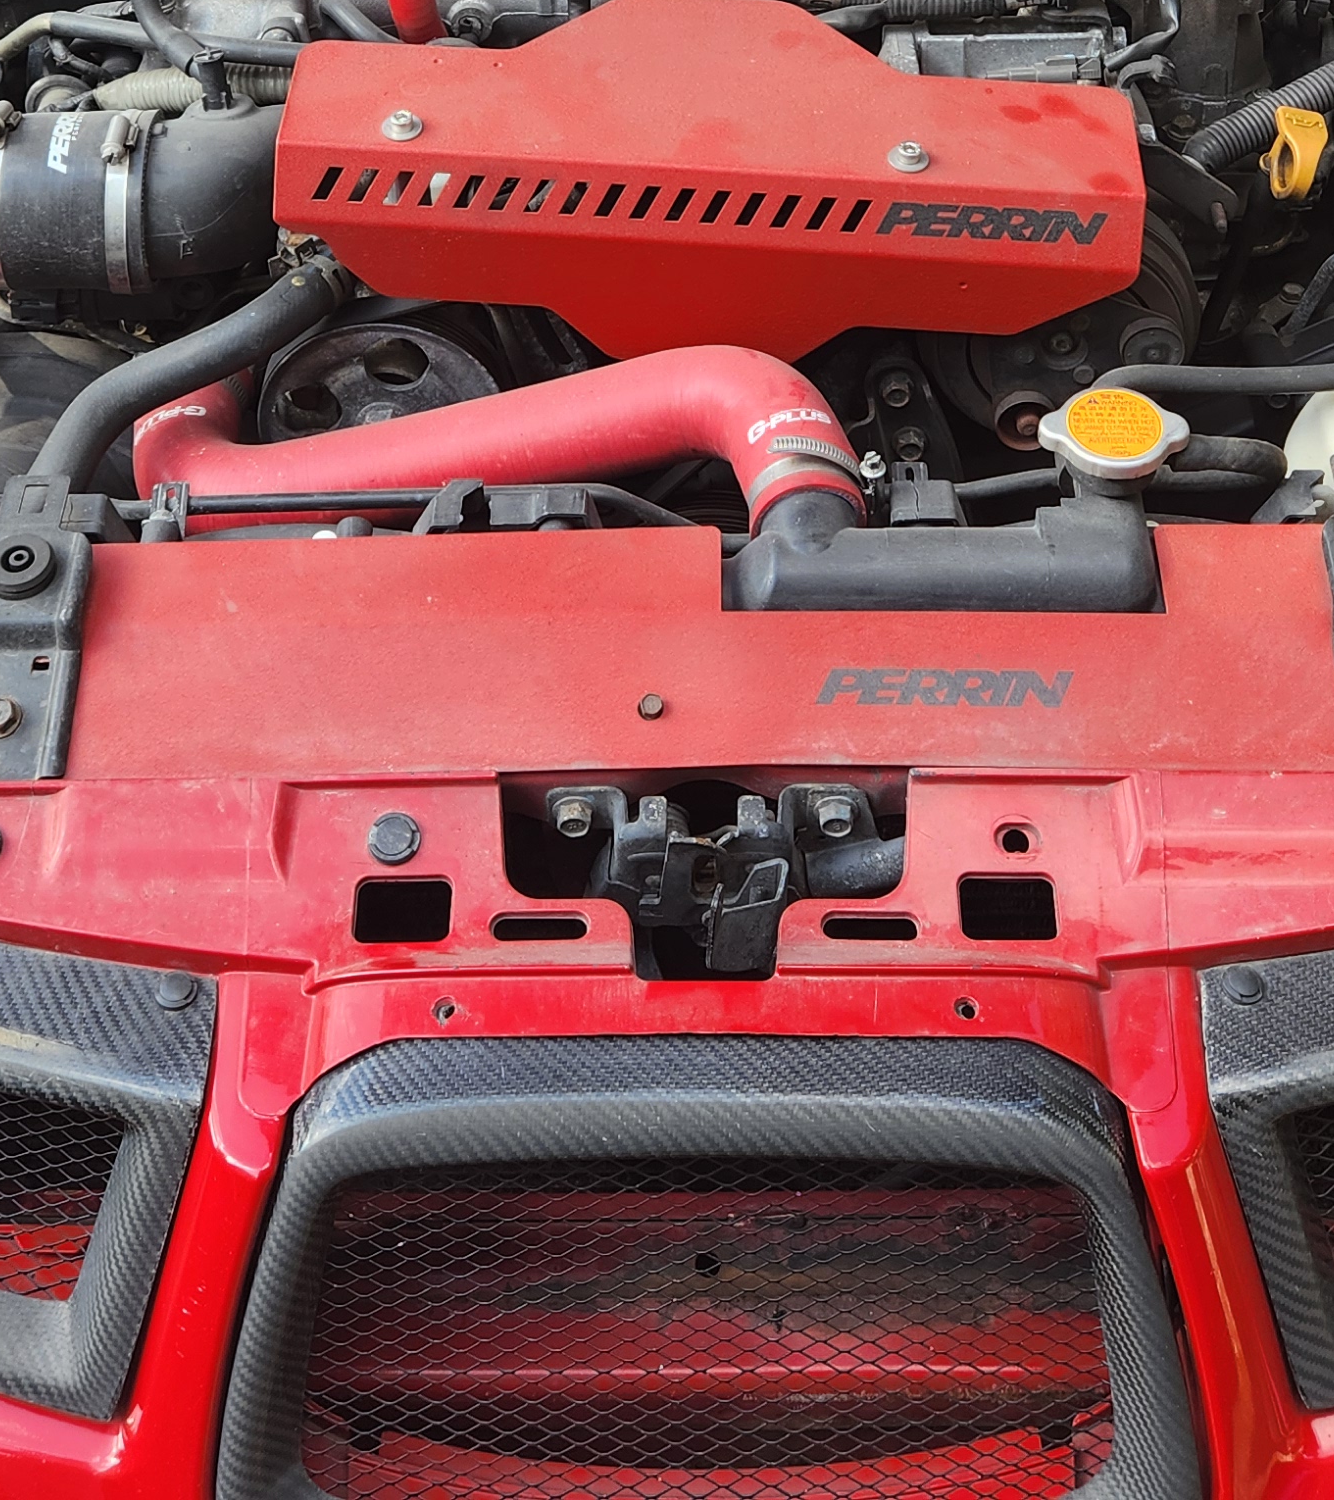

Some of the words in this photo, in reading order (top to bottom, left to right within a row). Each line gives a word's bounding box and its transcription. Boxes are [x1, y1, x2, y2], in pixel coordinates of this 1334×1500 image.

[875, 201, 1109, 245] PERRIN
[748, 407, 832, 445] G-PLUS
[815, 667, 1075, 708] PERRIN
